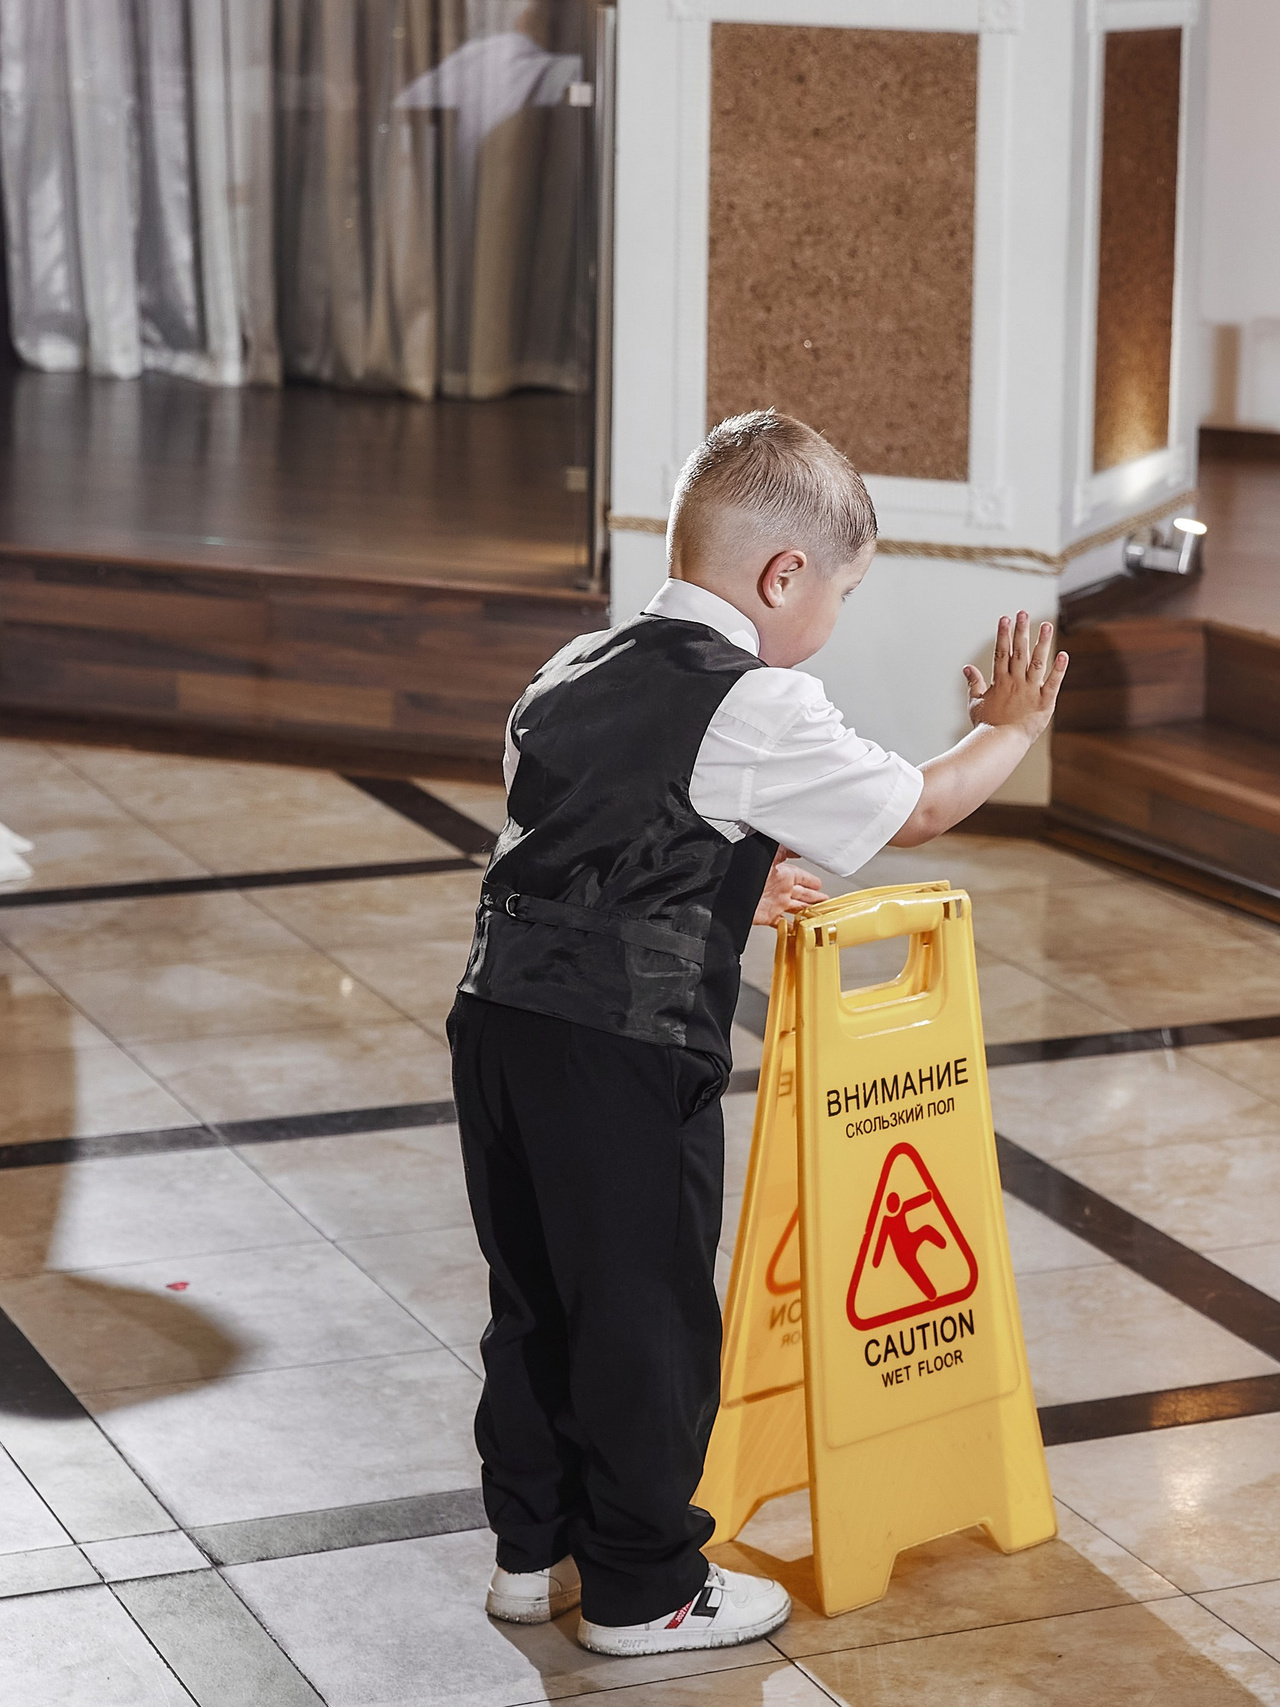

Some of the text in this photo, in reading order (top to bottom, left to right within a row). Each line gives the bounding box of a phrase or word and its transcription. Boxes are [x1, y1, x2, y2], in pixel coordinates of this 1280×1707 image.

[826, 1057, 969, 1117] ВНИМАНИЕ
[845, 1097, 955, 1138] СКОЛЬЗКИЙ ПОЛ
[864, 1309, 975, 1367] CAUTION
[881, 1349, 964, 1387] WET FLOOR
